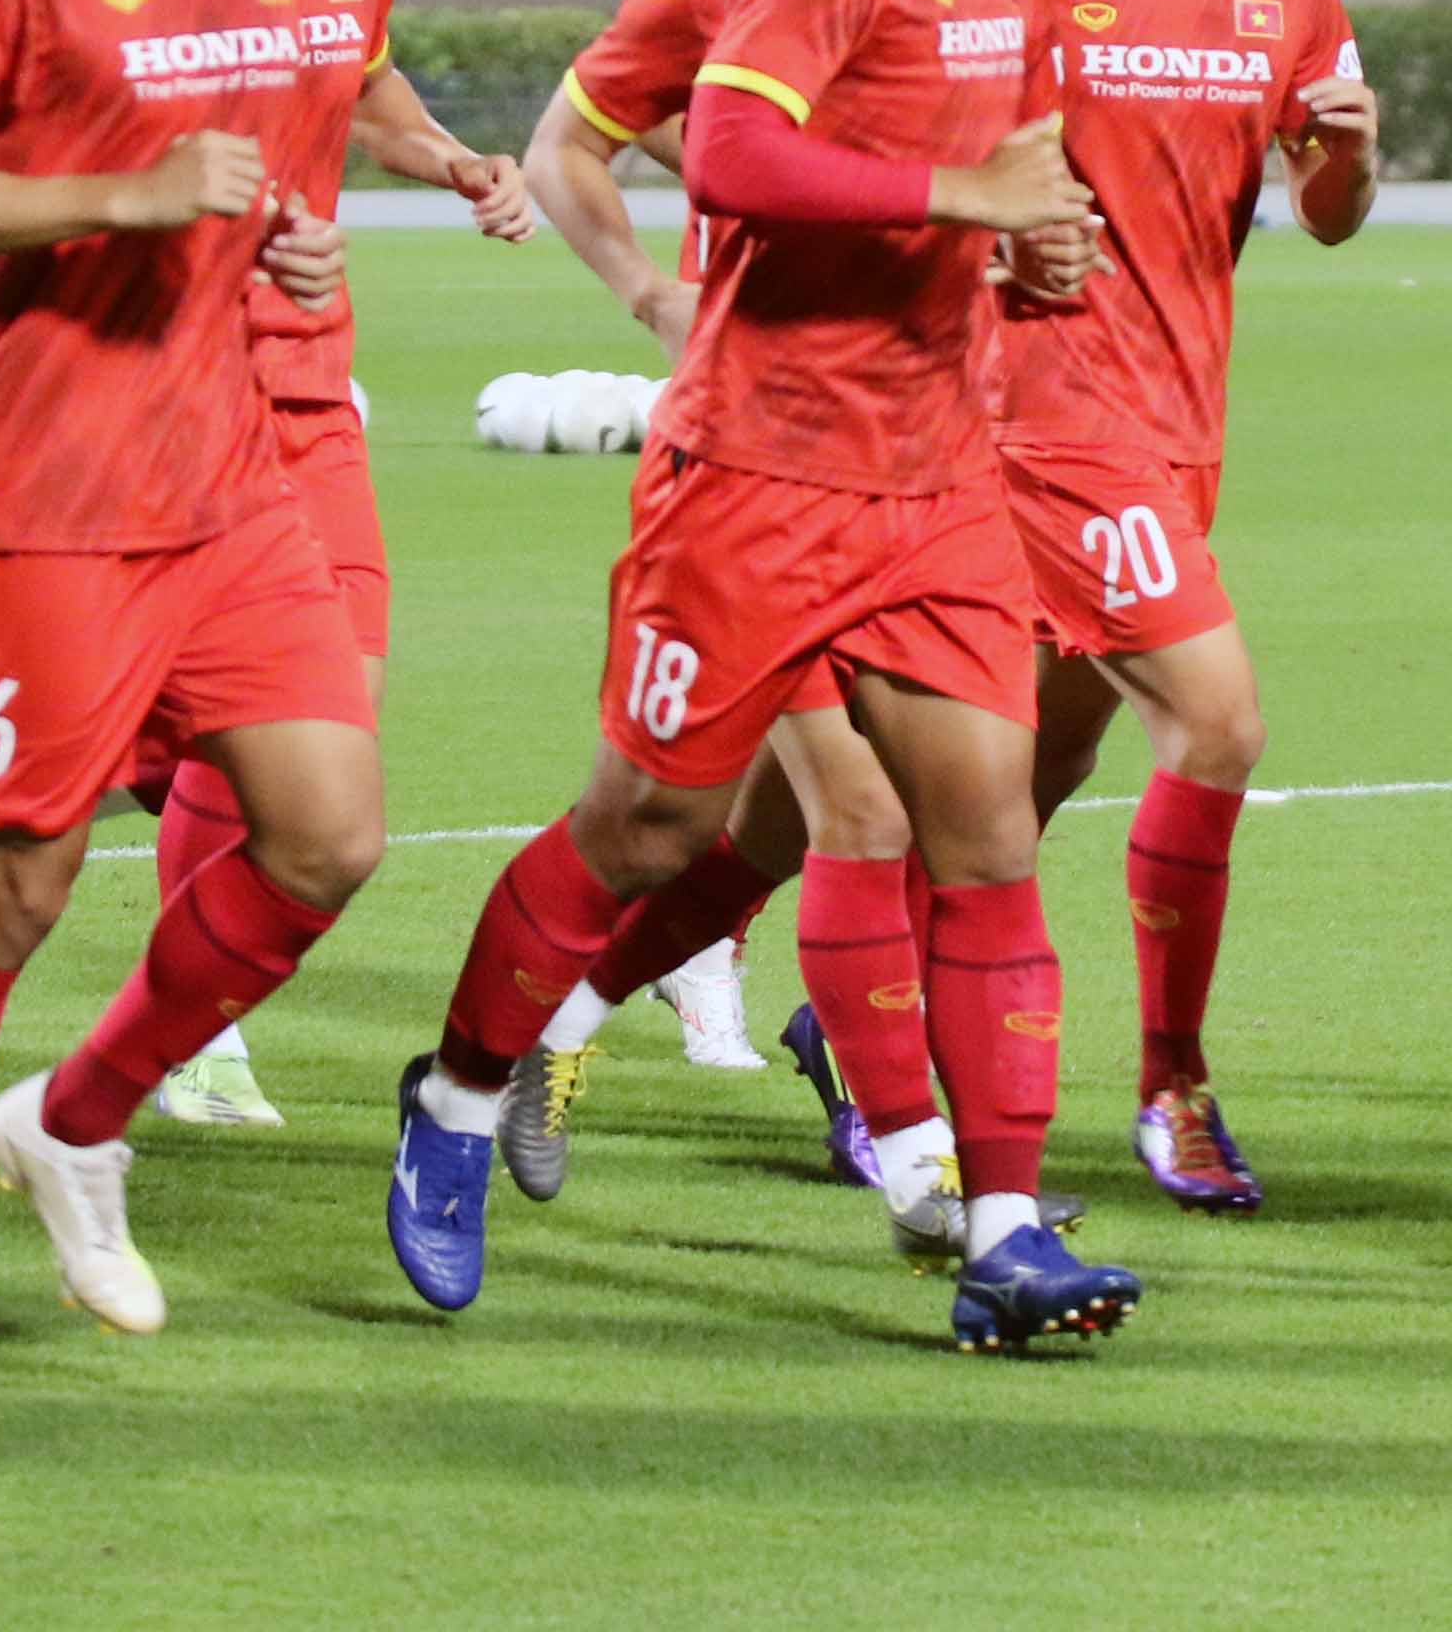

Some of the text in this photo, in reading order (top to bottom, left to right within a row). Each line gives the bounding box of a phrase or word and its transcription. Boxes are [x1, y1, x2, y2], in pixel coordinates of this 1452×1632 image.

[120, 26, 298, 77] HONDA
[938, 17, 1025, 56] HOND
[1080, 44, 1272, 82] HONDA
[1088, 79, 1126, 97] The
[1128, 81, 1181, 100] Power
[1186, 82, 1206, 100] of
[1082, 504, 1179, 608] 20
[625, 622, 699, 741] 18
